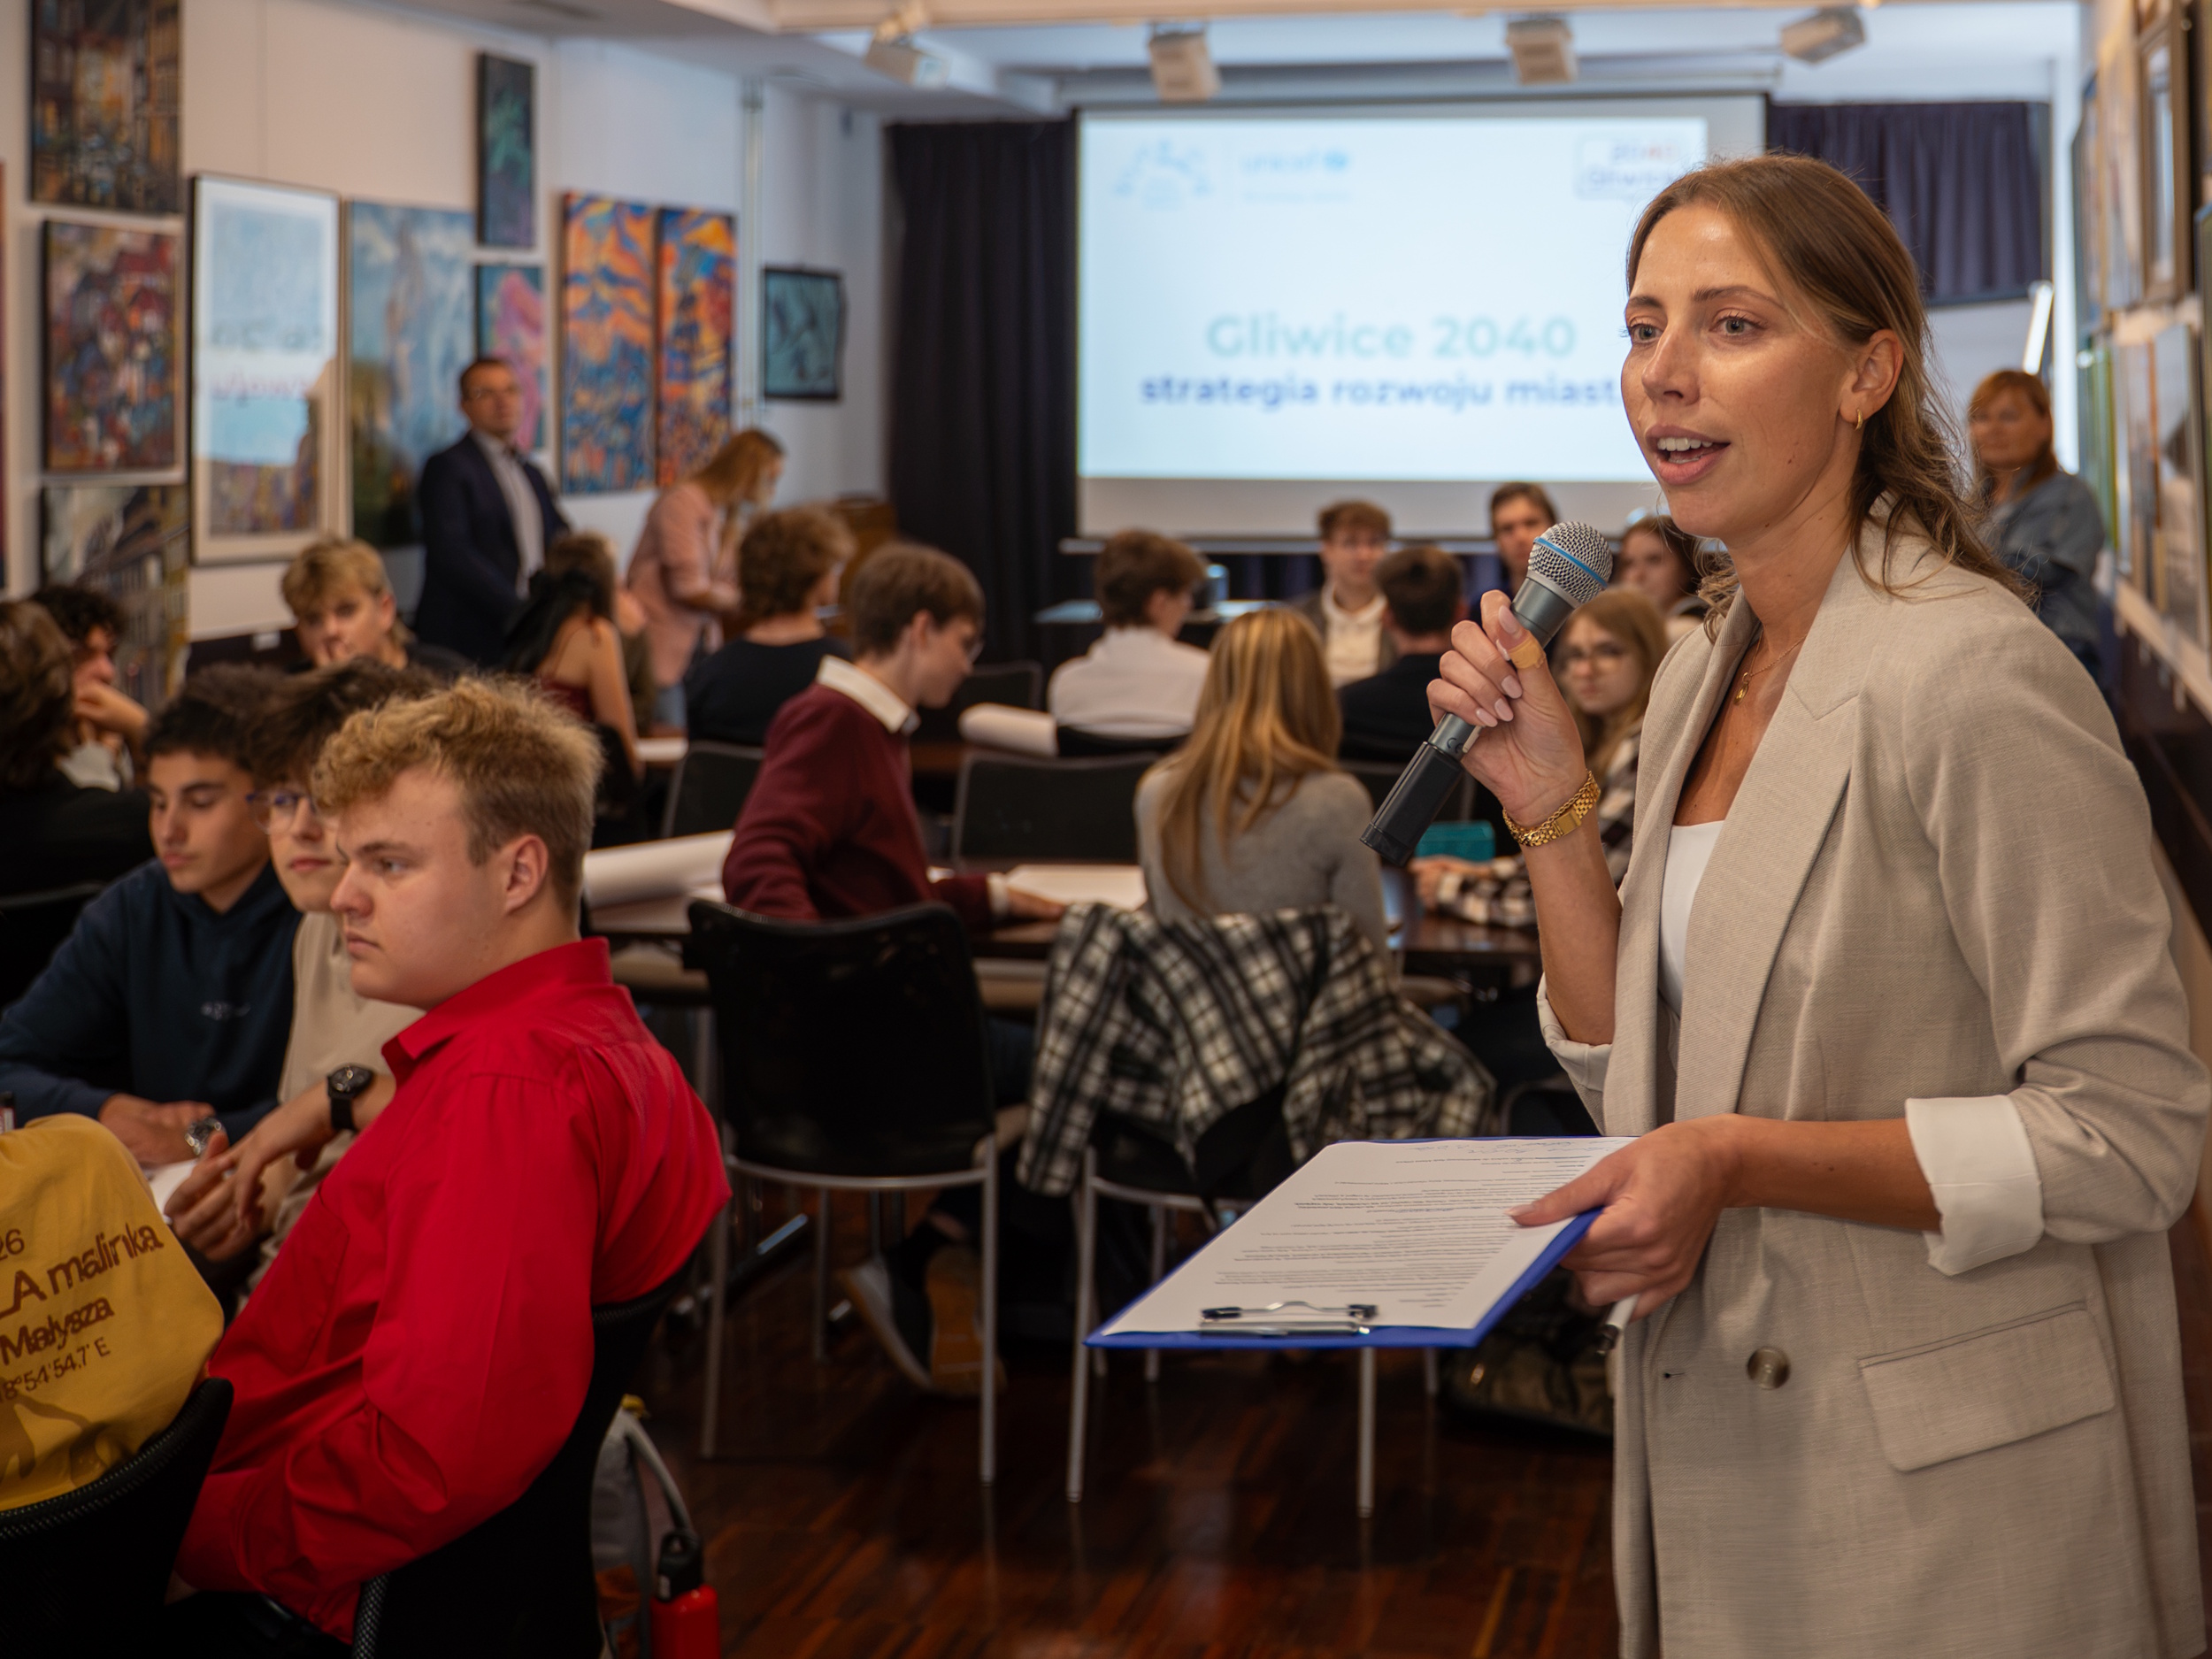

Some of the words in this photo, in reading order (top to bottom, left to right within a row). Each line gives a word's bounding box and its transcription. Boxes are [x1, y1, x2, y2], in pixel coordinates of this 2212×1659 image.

[1206, 314, 1415, 358] Gliwice
[1431, 315, 1577, 358] 2040
[1141, 375, 1317, 411] strategia
[1331, 375, 1492, 411] rozwoju
[1505, 375, 1621, 406] miast
[47, 1222, 165, 1295] malinka
[94, 1337, 111, 1357] E
